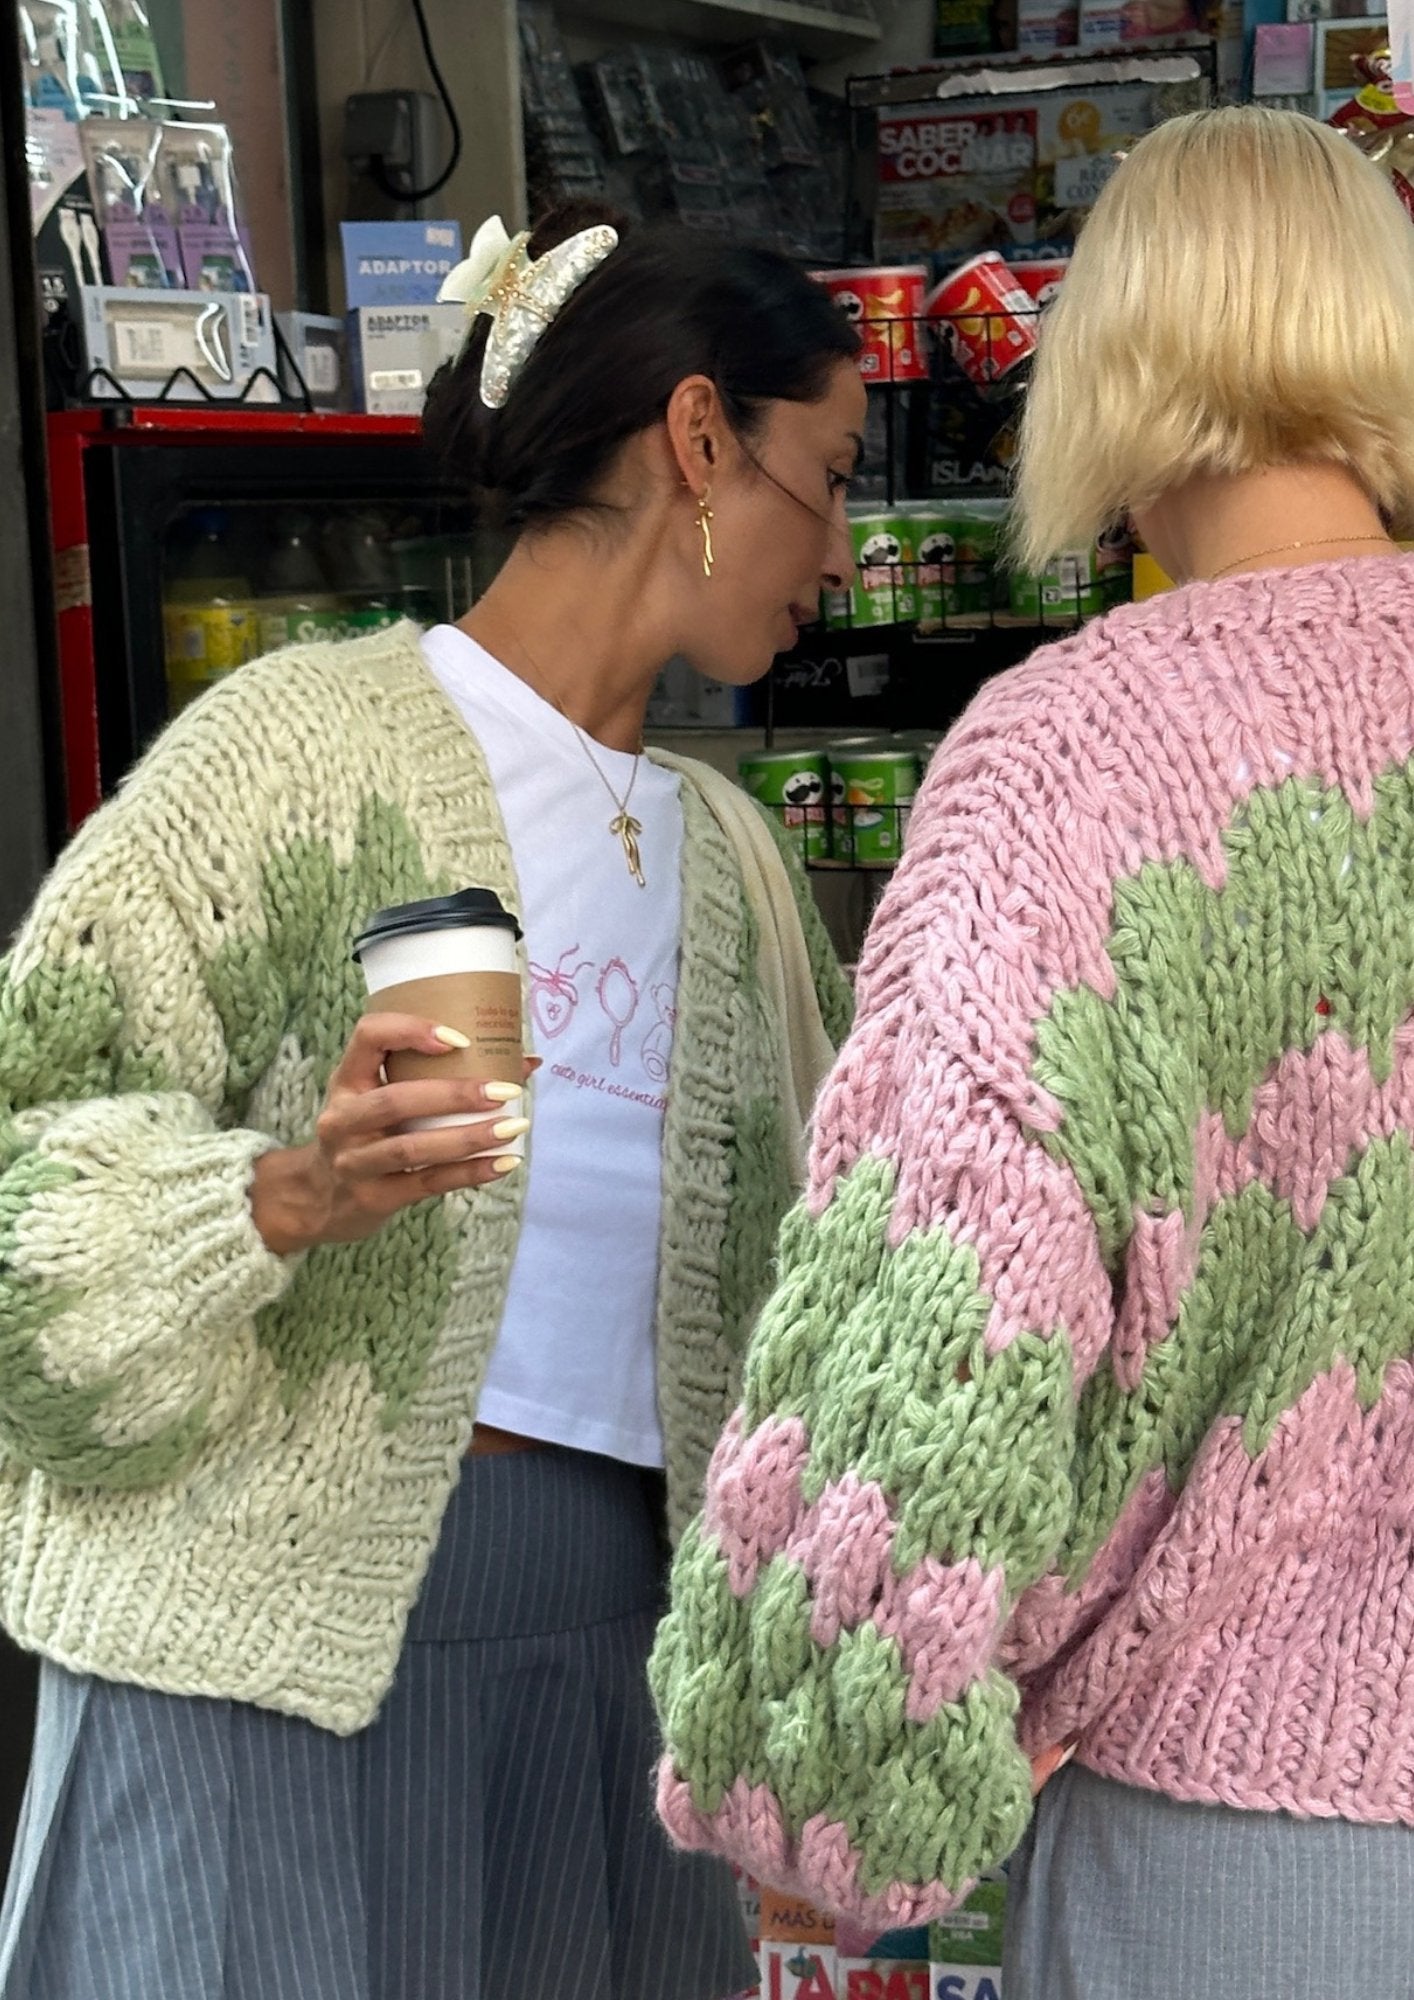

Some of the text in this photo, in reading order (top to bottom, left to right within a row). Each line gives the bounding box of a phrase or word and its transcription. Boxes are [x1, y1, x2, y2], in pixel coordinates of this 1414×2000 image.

[879, 121, 977, 153] SABER
[897, 142, 1032, 178] COCINAR
[359, 259, 451, 276] ADAPTOR
[367, 314, 430, 328] ADAPTOR
[551, 1063, 576, 1081] cute
[576, 1073, 606, 1090] girl
